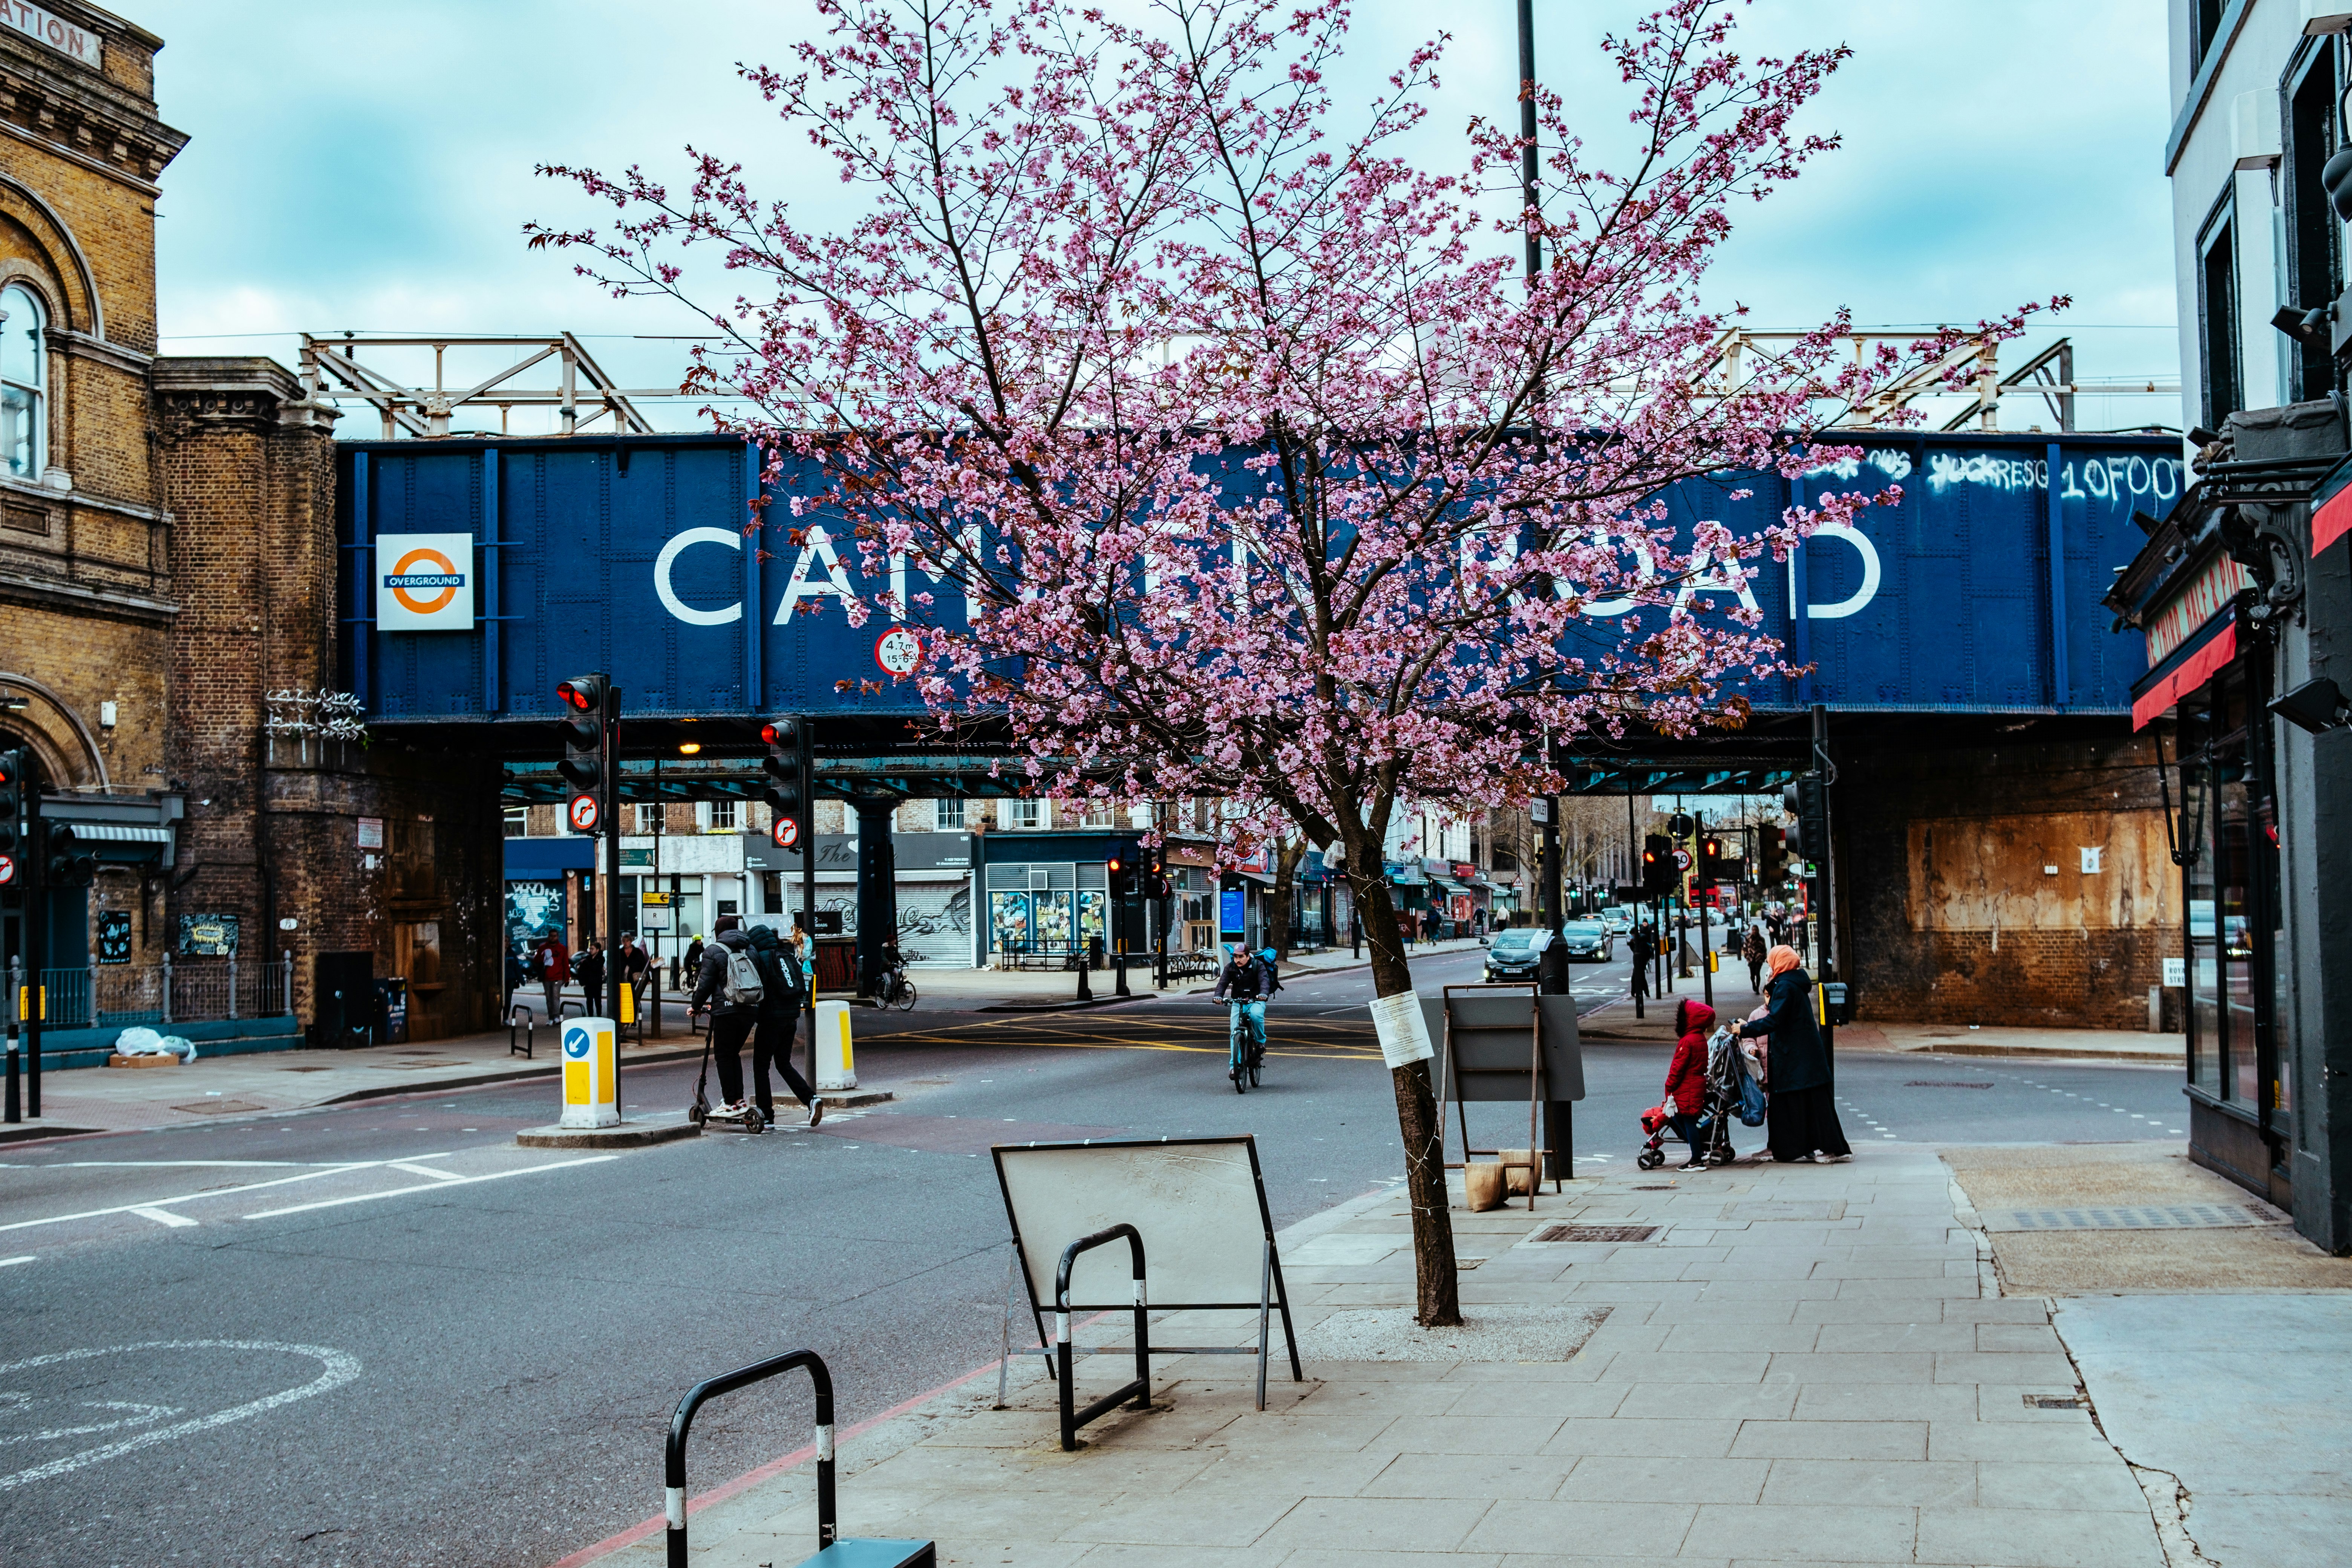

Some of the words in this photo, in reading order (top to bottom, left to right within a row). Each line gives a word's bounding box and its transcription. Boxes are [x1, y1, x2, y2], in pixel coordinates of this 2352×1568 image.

[389, 577, 459, 586] OVERGROUND
[2184, 576, 2208, 635] HALF
[2209, 566, 2220, 610] &
[1534, 803, 1547, 815] TOILET
[815, 842, 850, 862] The
